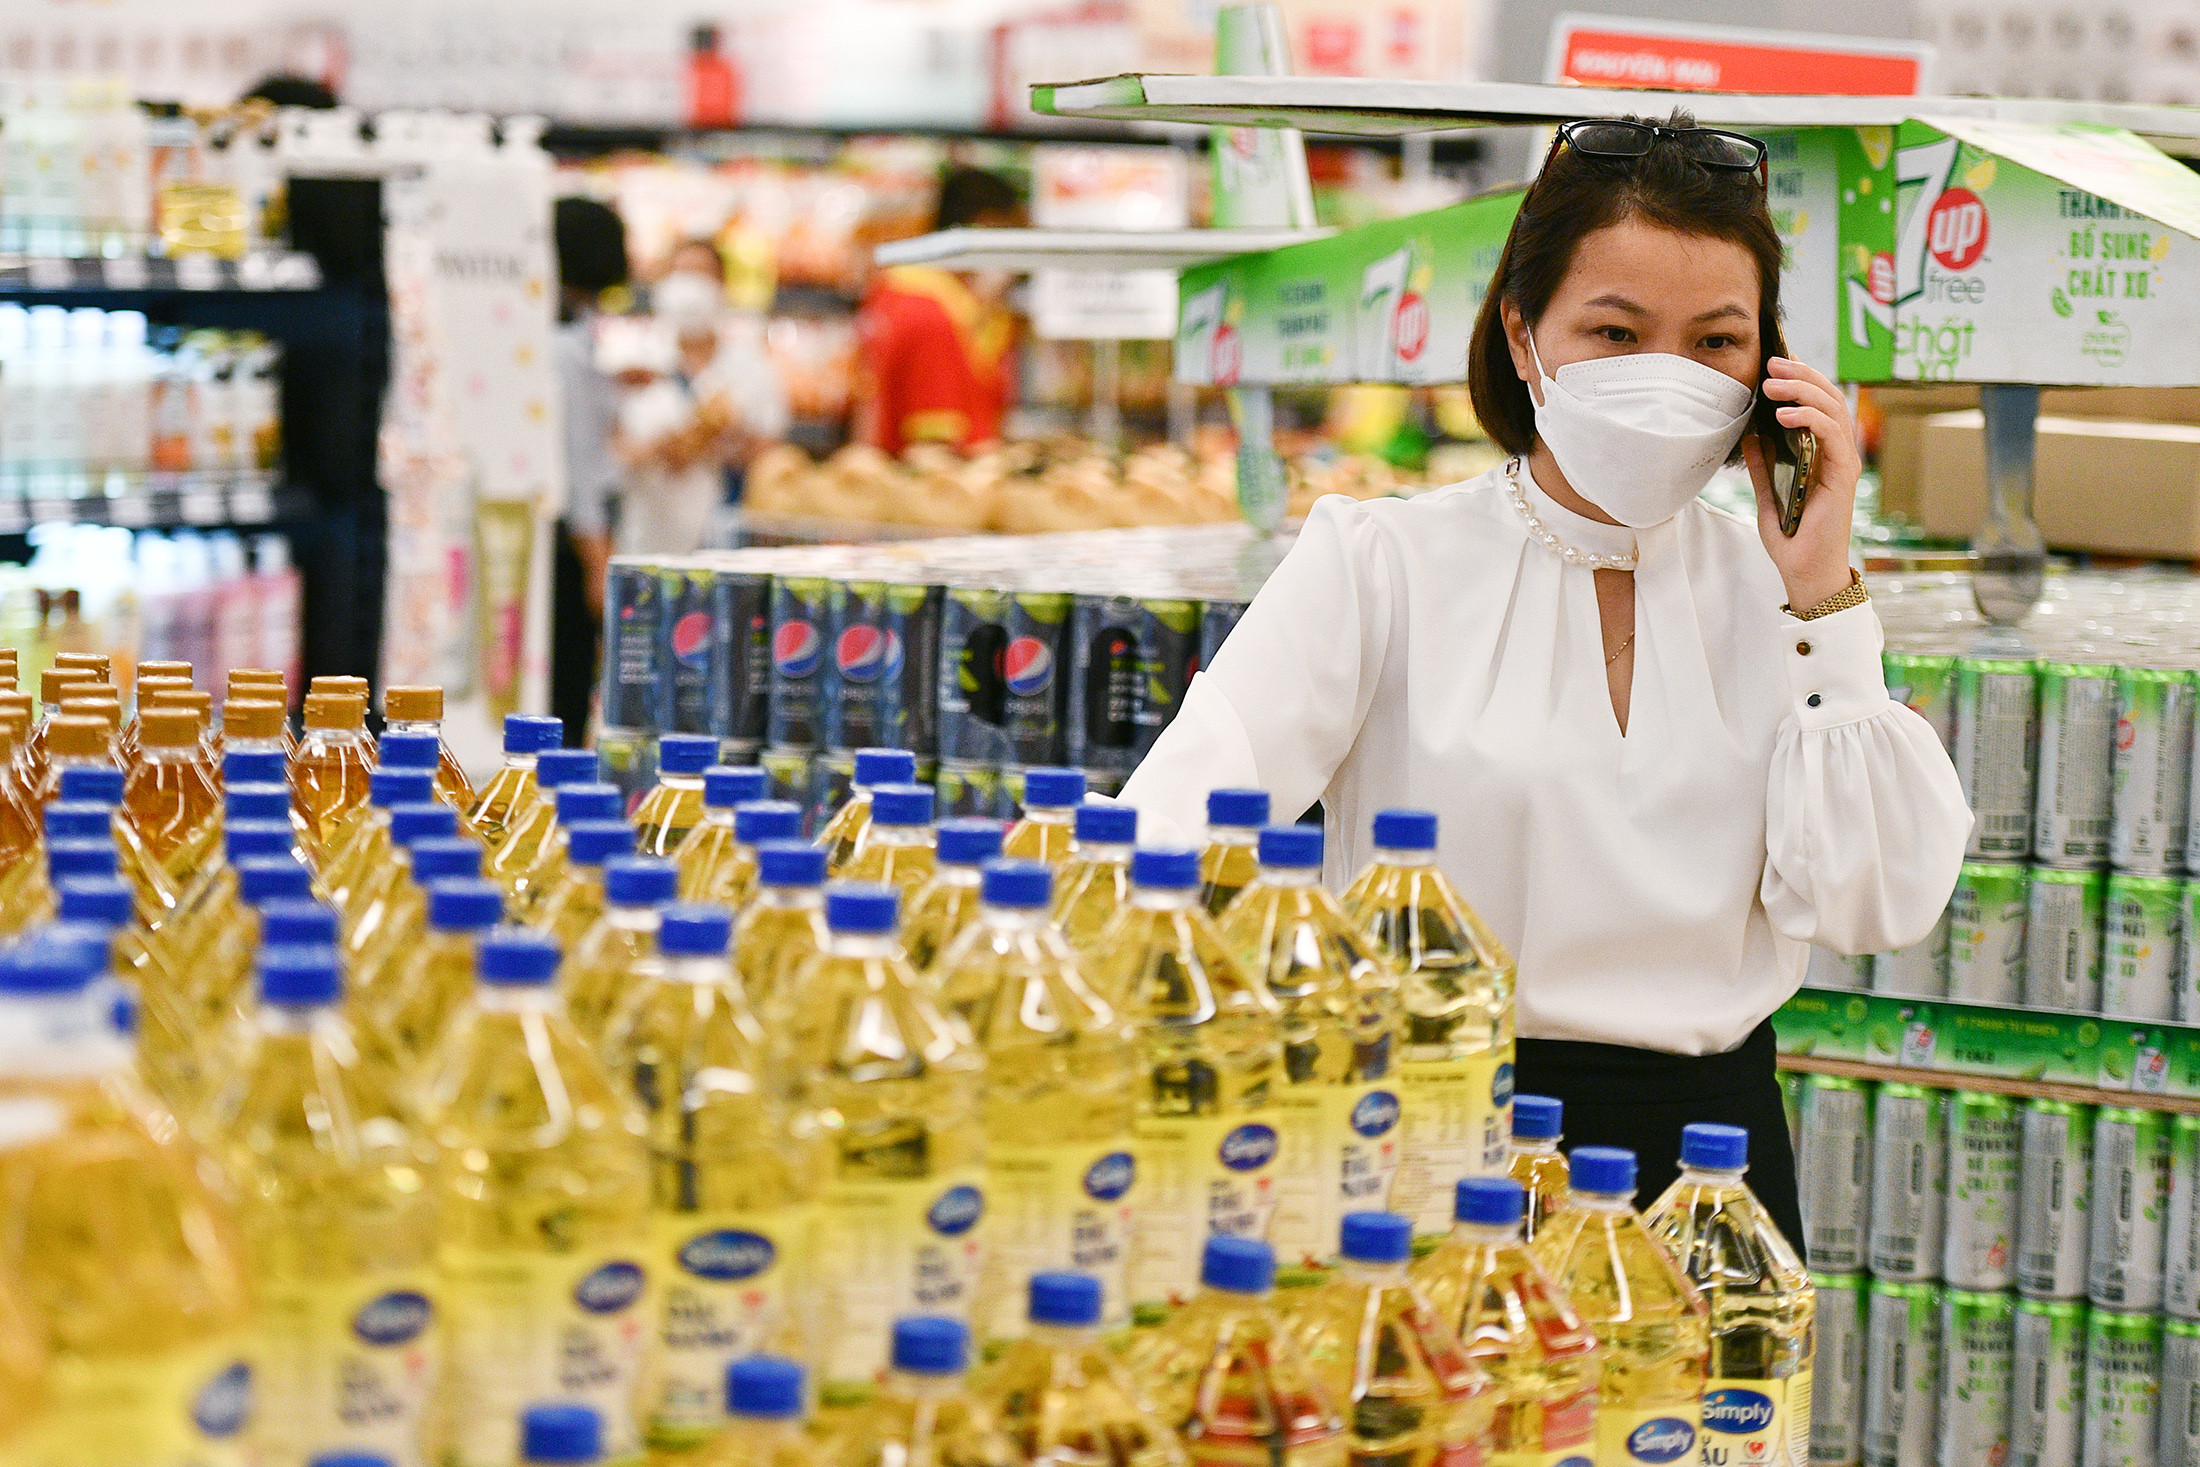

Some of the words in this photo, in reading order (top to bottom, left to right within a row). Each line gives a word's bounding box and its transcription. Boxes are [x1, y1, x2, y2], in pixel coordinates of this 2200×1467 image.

[1927, 268, 1986, 304] free
[1703, 1395, 1774, 1425] Simply
[1633, 1426, 1695, 1453] Simply
